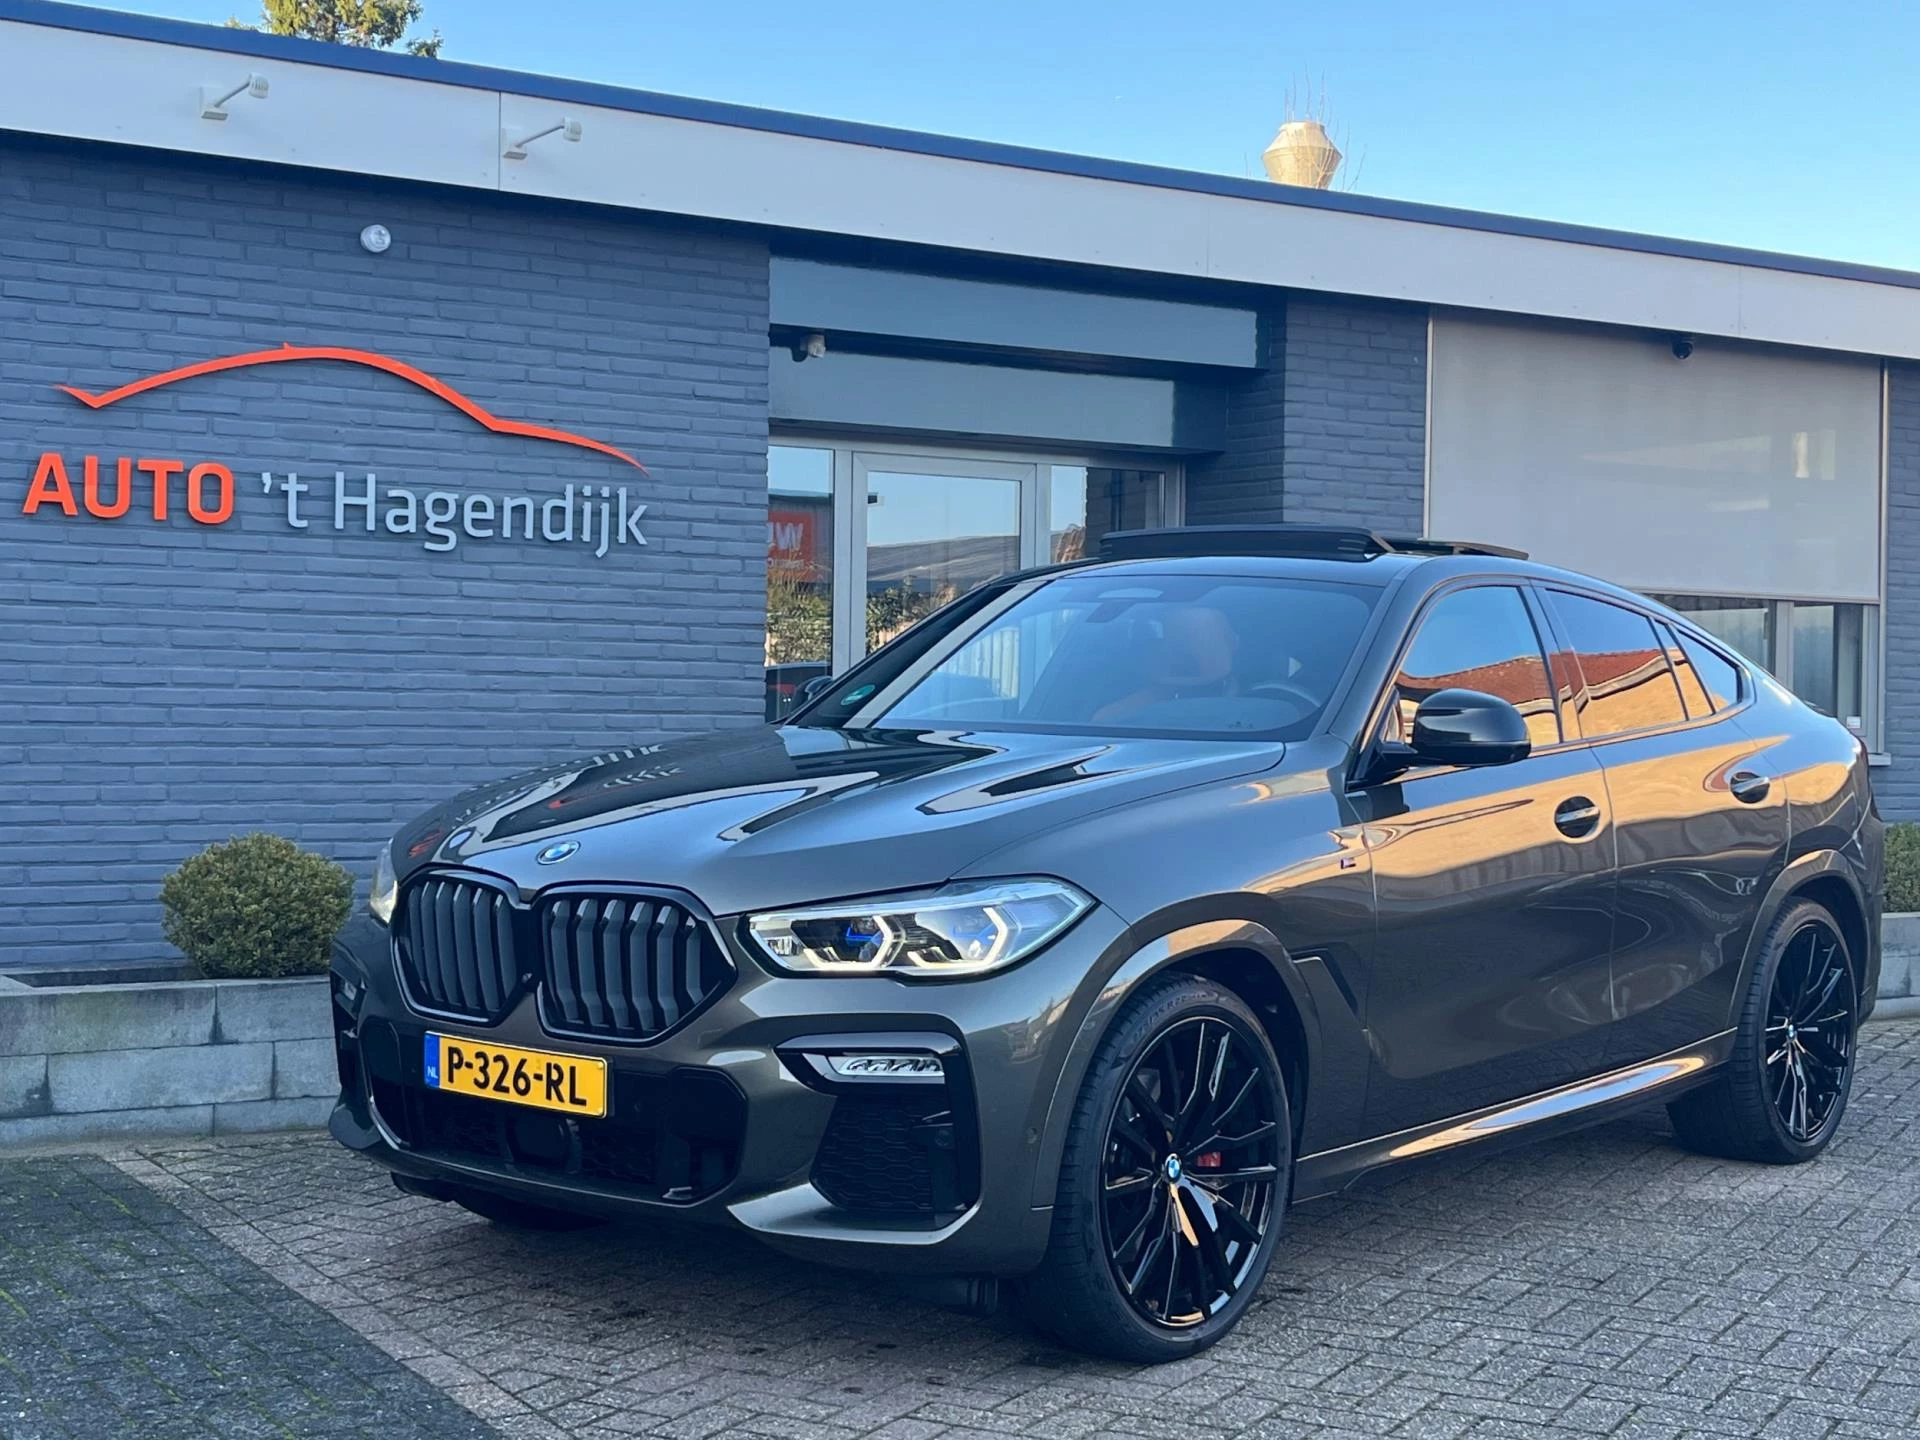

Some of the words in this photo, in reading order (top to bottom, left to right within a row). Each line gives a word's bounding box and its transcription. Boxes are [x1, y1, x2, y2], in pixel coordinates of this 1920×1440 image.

[23, 452, 235, 525] AUTO
[261, 472, 309, 529] 't
[333, 470, 649, 559] Hagendijk
[427, 1065, 439, 1079] NL
[447, 1046, 587, 1107] P-326-RL
